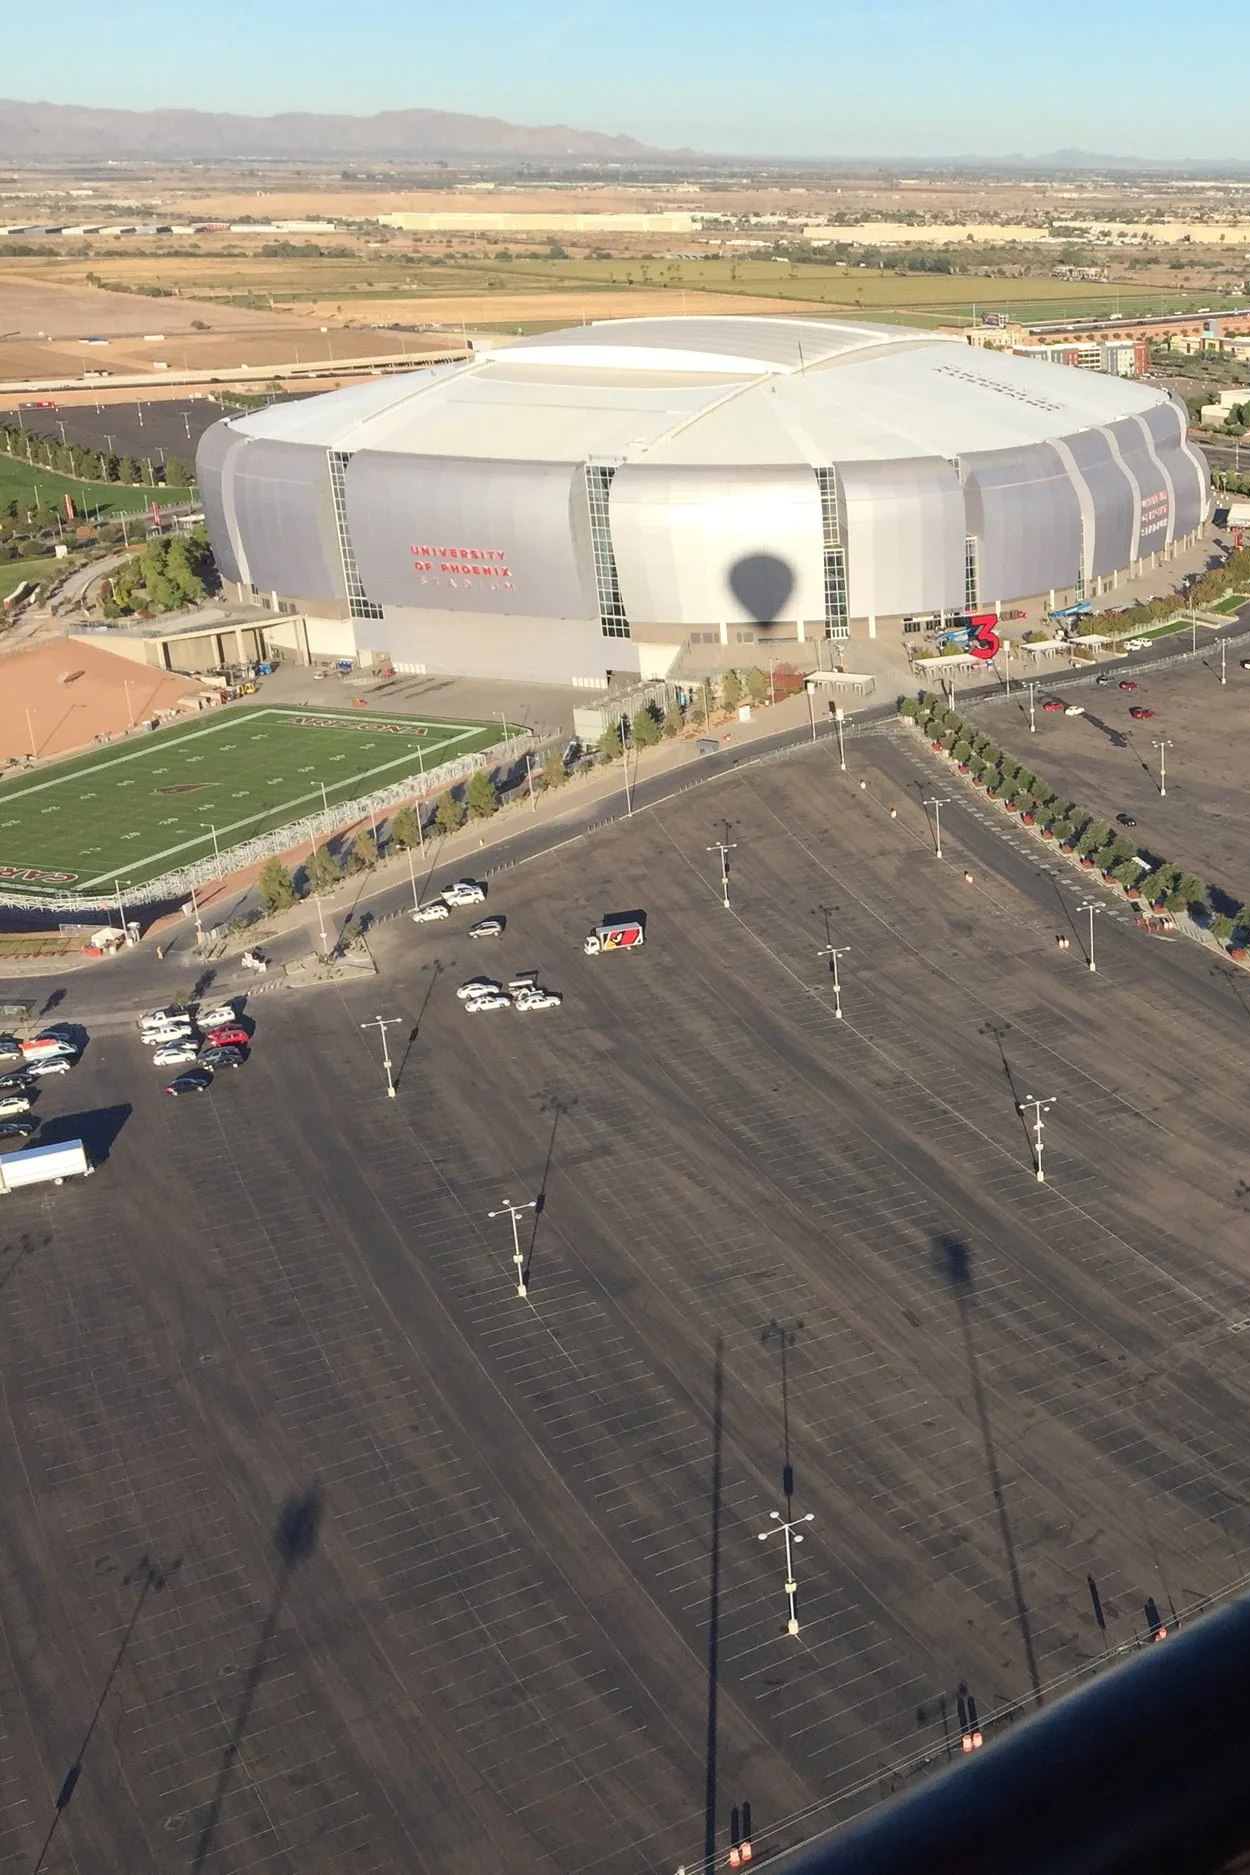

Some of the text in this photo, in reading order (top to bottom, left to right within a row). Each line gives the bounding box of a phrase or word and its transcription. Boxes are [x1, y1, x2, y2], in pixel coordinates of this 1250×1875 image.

[410, 545, 505, 560] UNIVERSITY
[415, 562, 512, 577] OF PHOENIX
[970, 614, 1000, 660] 3
